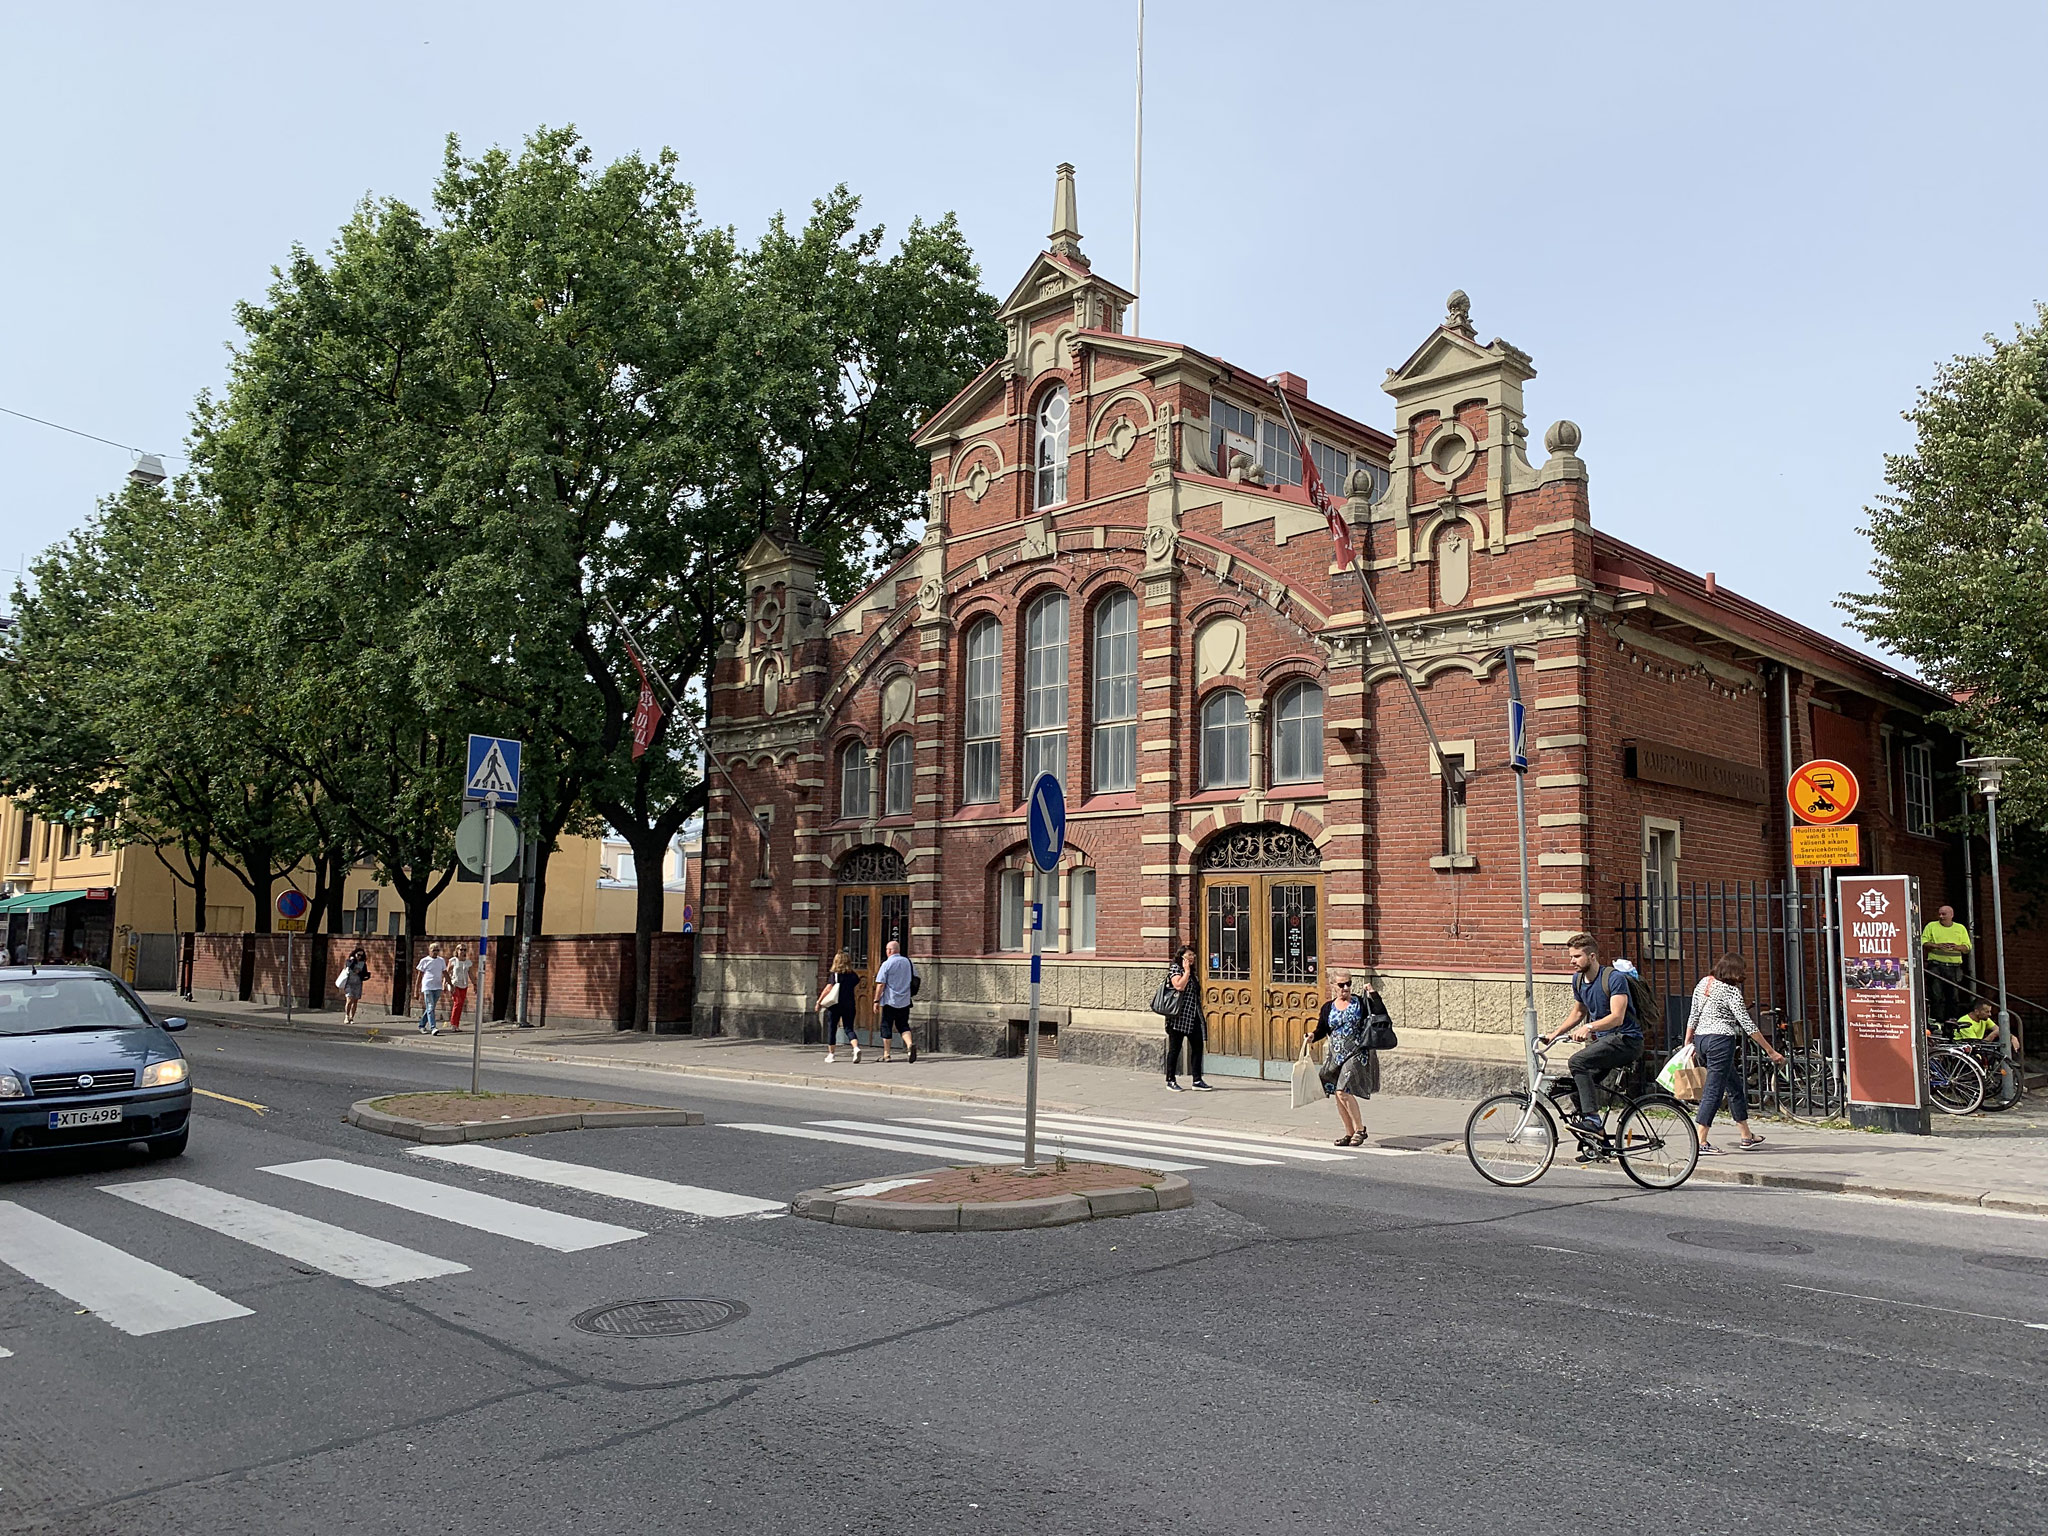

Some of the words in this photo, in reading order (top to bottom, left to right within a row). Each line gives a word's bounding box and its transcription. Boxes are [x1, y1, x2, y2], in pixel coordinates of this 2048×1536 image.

[1852, 922, 1900, 937] KAUPPA-
[1859, 938, 1892, 954] HALLI
[60, 1109, 118, 1125] XTG-498
